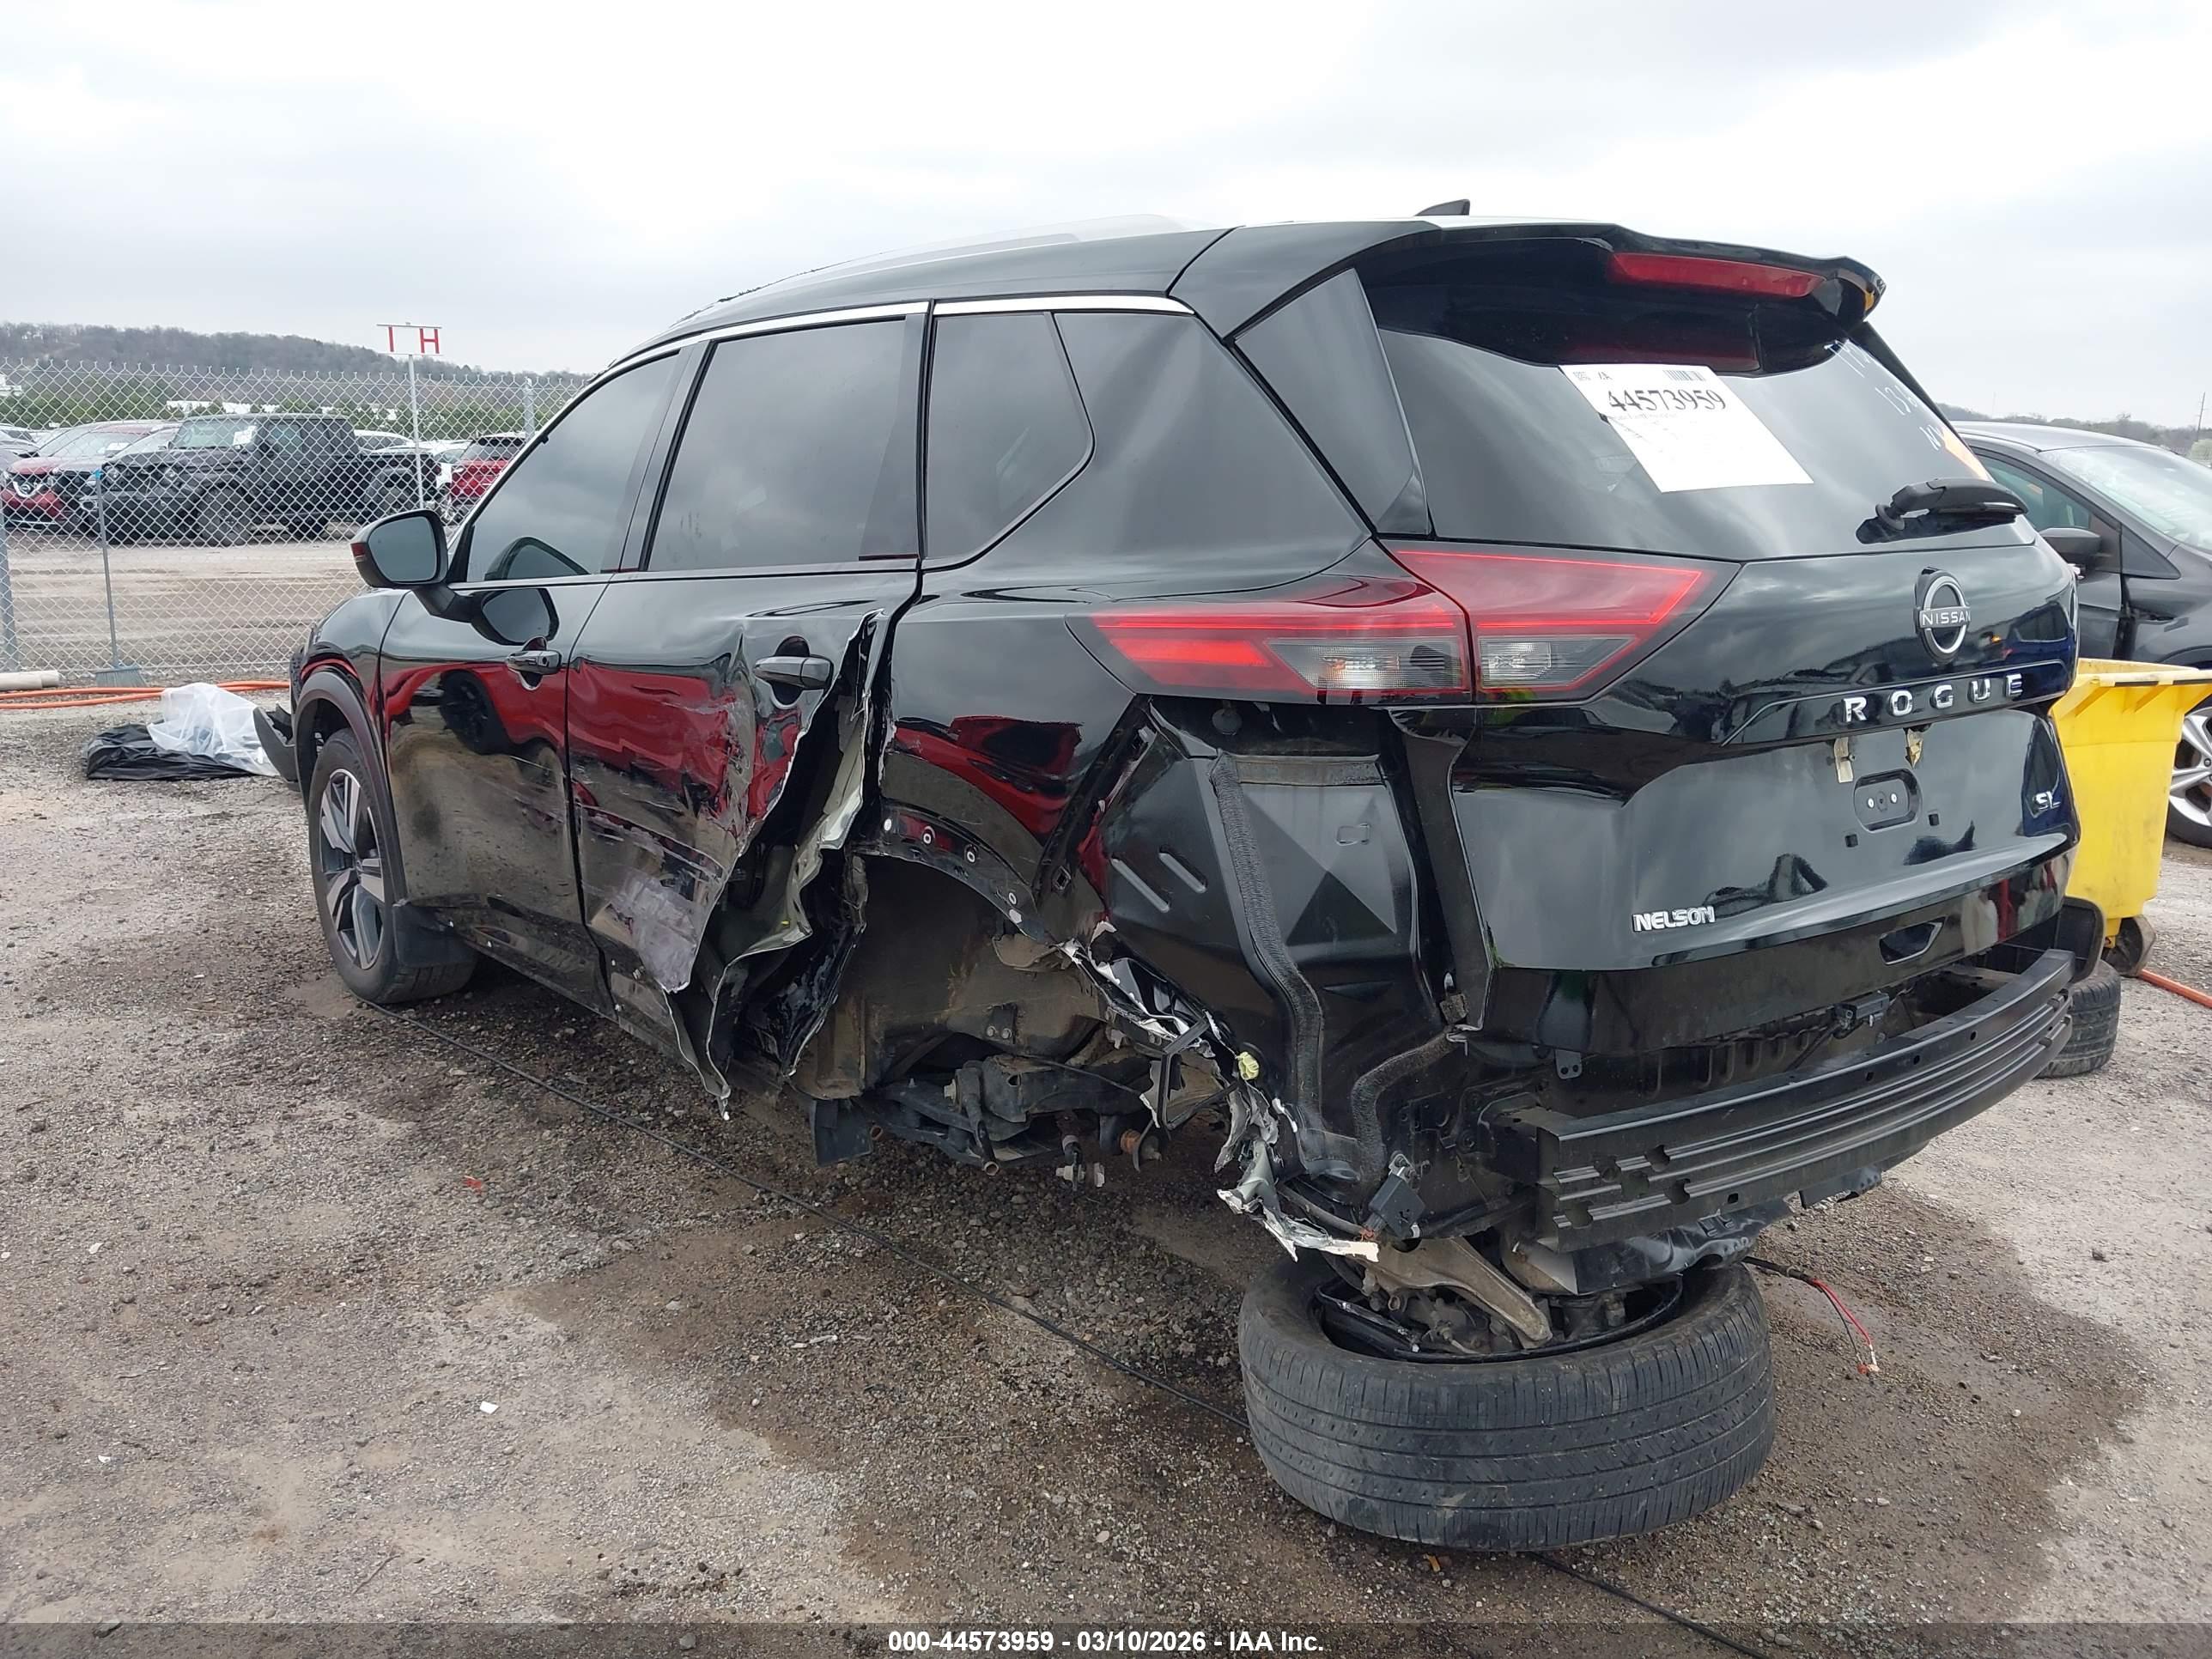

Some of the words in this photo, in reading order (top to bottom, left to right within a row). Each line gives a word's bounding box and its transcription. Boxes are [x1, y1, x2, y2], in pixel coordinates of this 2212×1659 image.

[1607, 389, 1727, 411] 44573959
[1921, 609, 1971, 626] NISSAN
[1842, 672, 2023, 722] ROGUE
[2034, 791, 2060, 811] SL
[1632, 905, 1716, 933] NELSON
